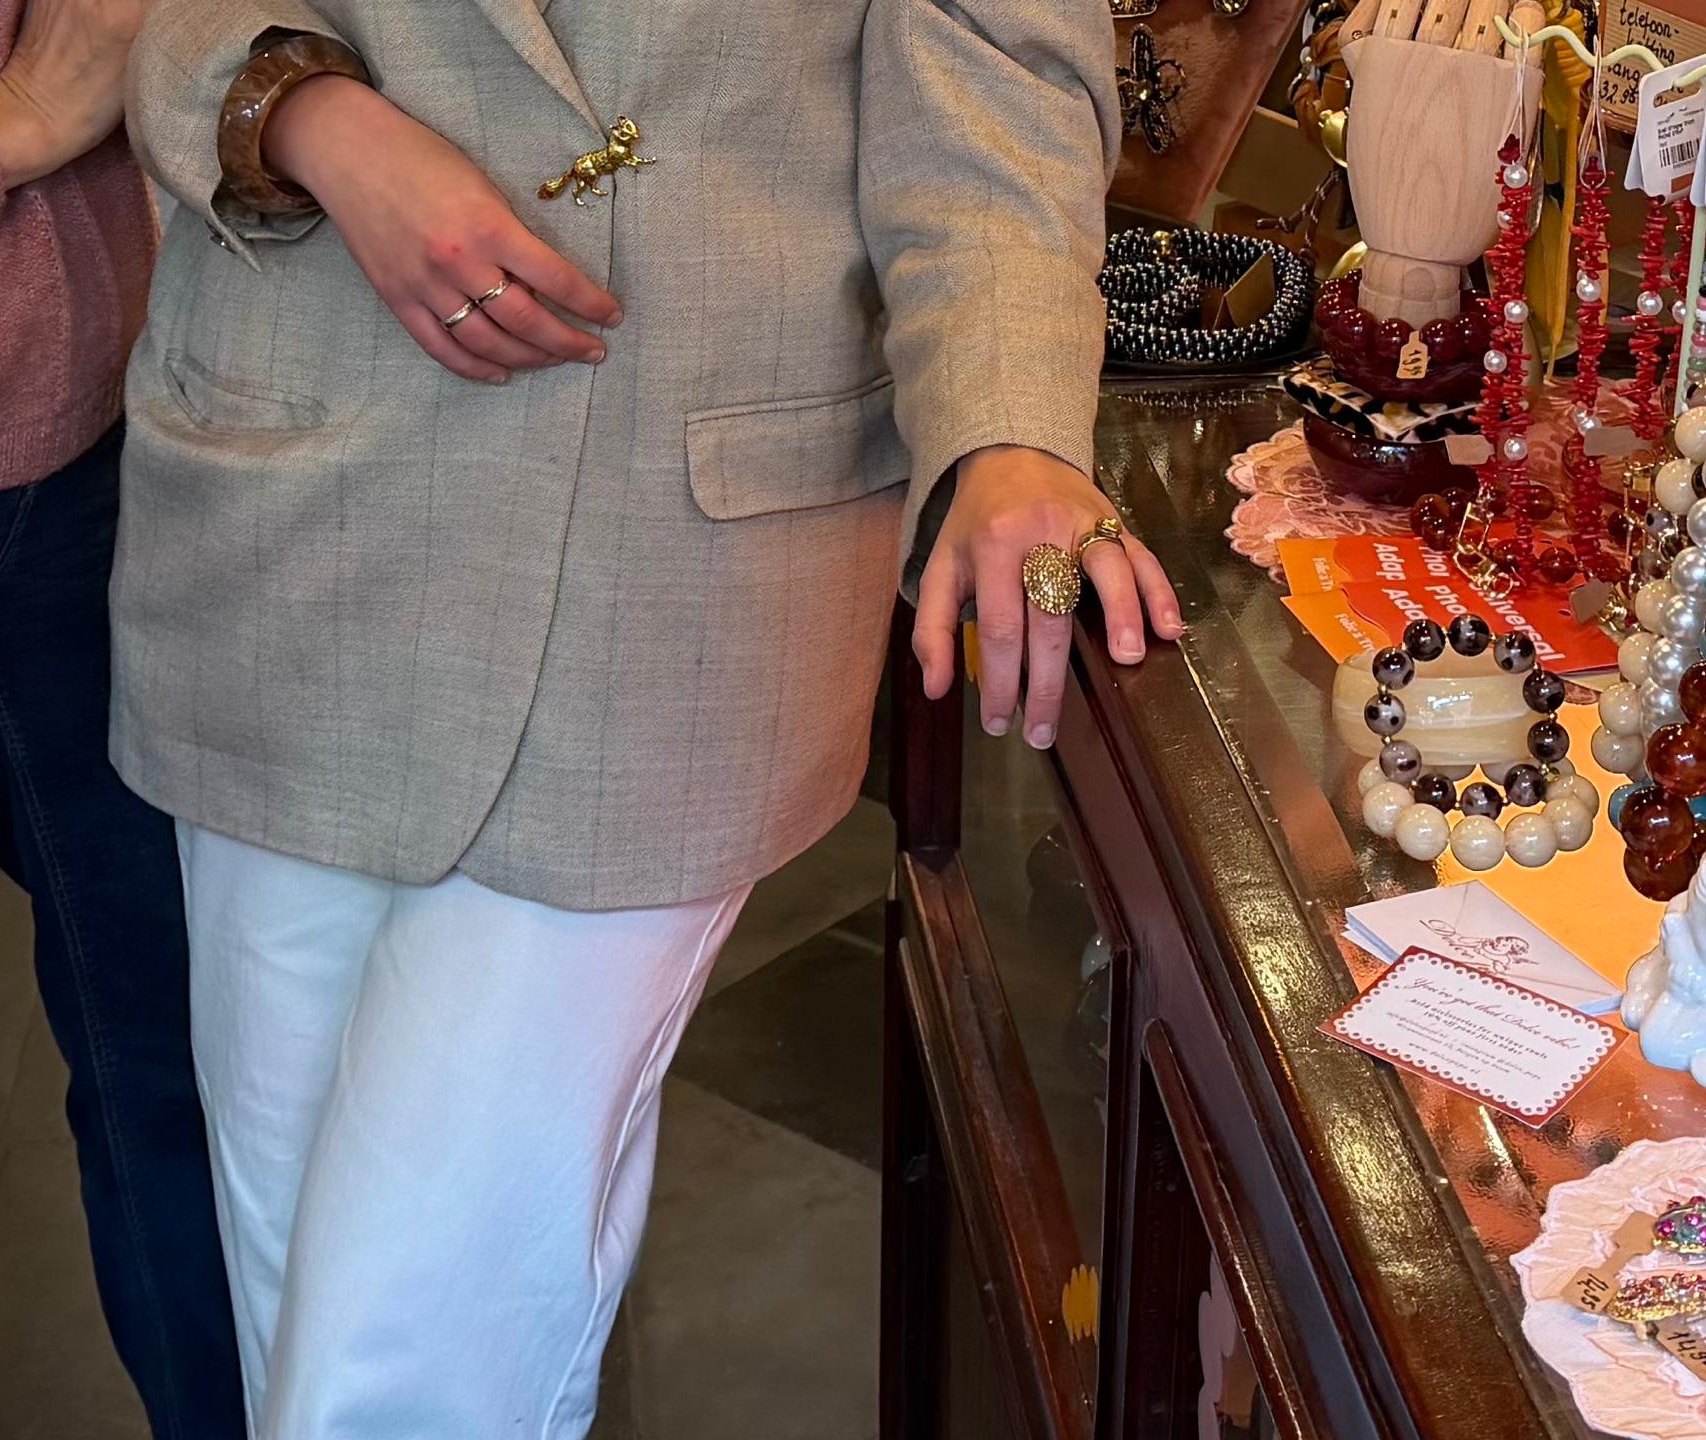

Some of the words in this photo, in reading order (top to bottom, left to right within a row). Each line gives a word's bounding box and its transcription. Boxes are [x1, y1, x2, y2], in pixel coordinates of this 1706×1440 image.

[1626, 28, 1675, 64] ktting
[1381, 588, 1429, 624] Ada
[1425, 585, 1468, 615] Pho
